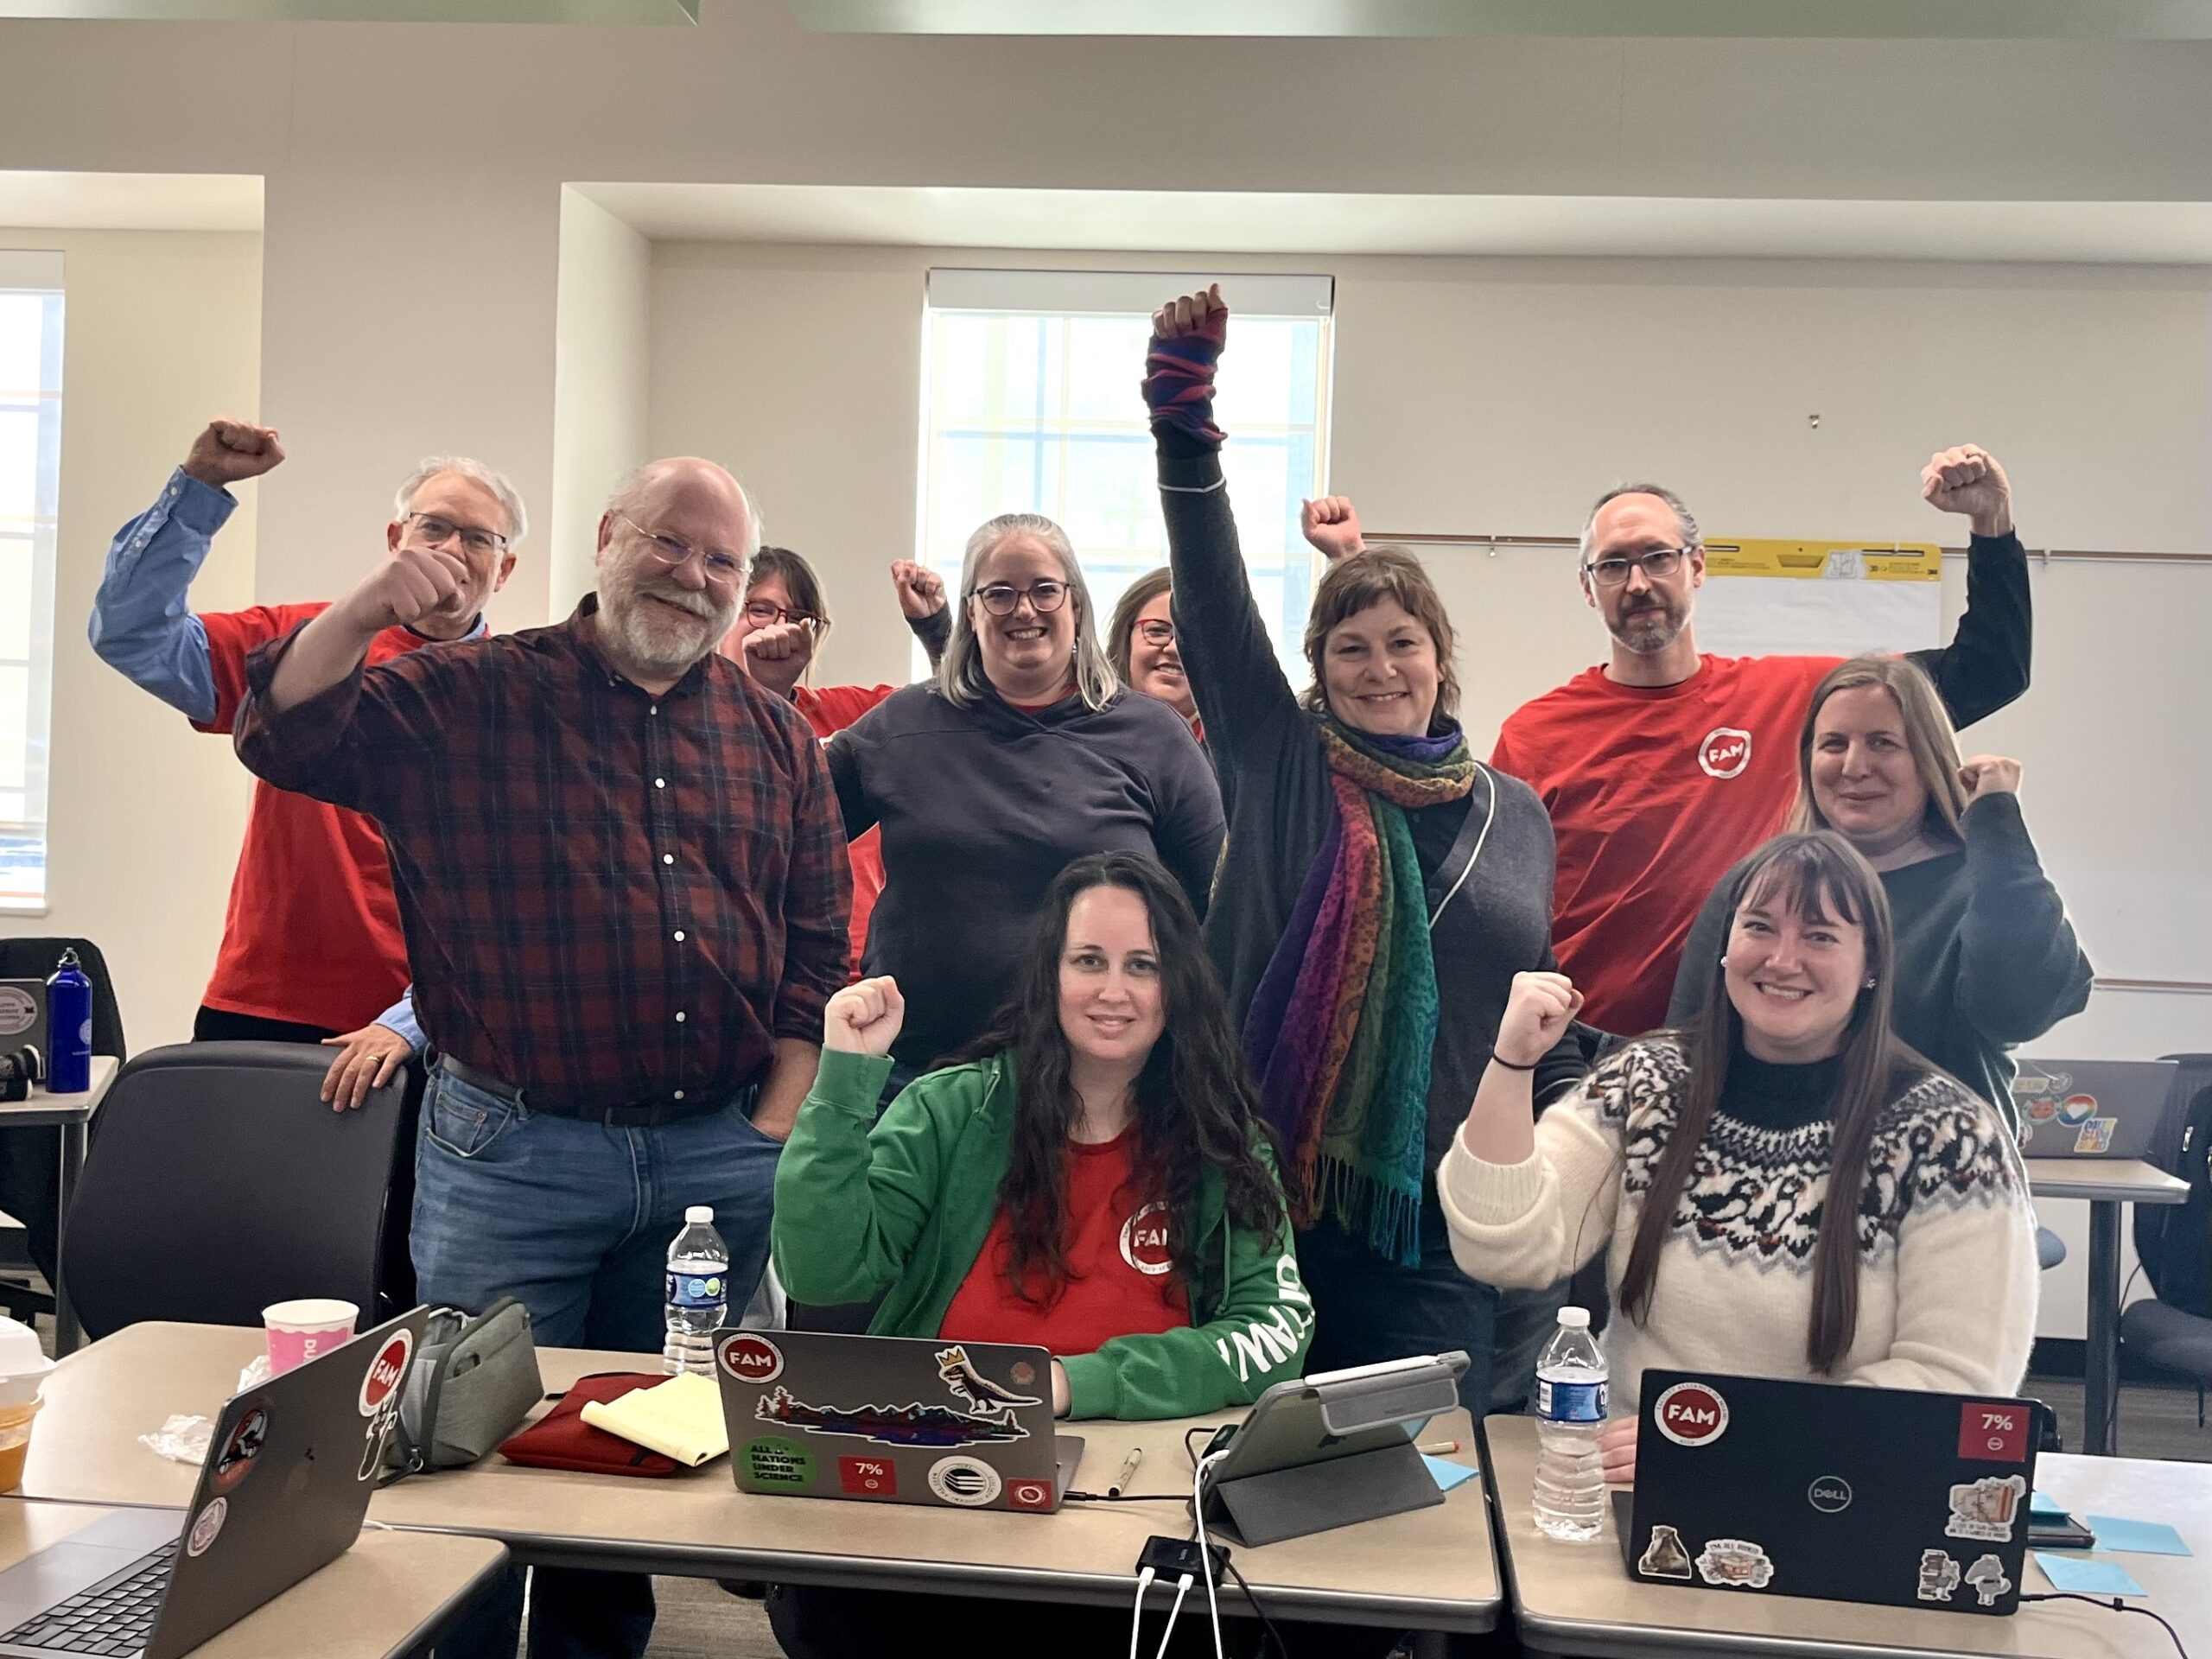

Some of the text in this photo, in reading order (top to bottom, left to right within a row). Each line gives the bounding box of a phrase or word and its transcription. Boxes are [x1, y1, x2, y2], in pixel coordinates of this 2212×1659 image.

[1709, 742, 1745, 763] FAM
[304, 1339, 317, 1360] DU
[729, 1351, 772, 1367] FAM
[374, 1359, 399, 1387] FAM
[1668, 1404, 1715, 1426] FAM
[1981, 1414, 2013, 1431] 7%
[751, 1445, 772, 1454] ALL
[751, 1454, 806, 1465] NATIONS
[753, 1463, 794, 1472] UNDER
[855, 1462, 883, 1476] 7%
[753, 1471, 804, 1483] SCIENCE
[1814, 1489, 1847, 1501] DELL
